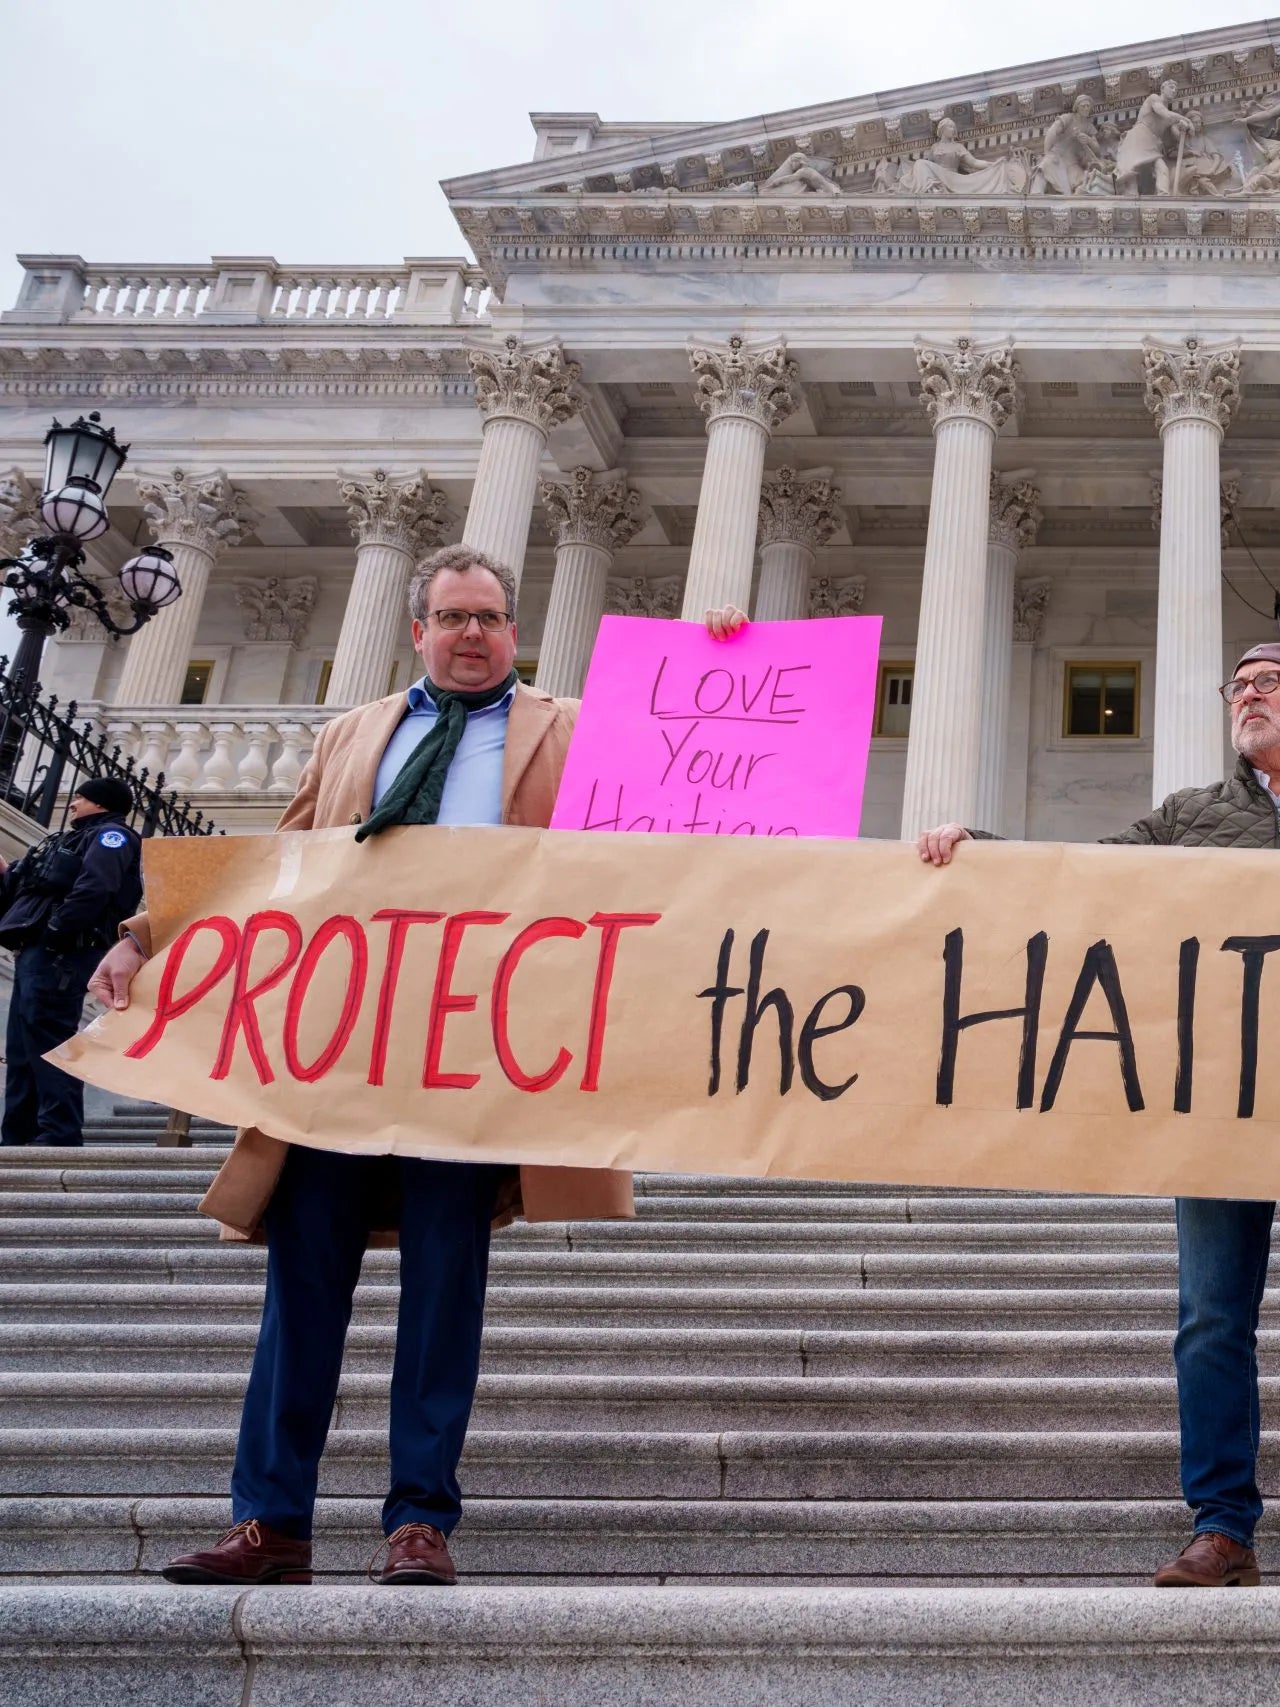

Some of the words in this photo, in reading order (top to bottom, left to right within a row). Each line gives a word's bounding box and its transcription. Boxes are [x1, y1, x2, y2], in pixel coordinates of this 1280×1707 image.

[650, 656, 811, 715] LOVE
[660, 721, 779, 790] Your
[122, 908, 662, 1095] PROTECT
[695, 927, 866, 1101] the
